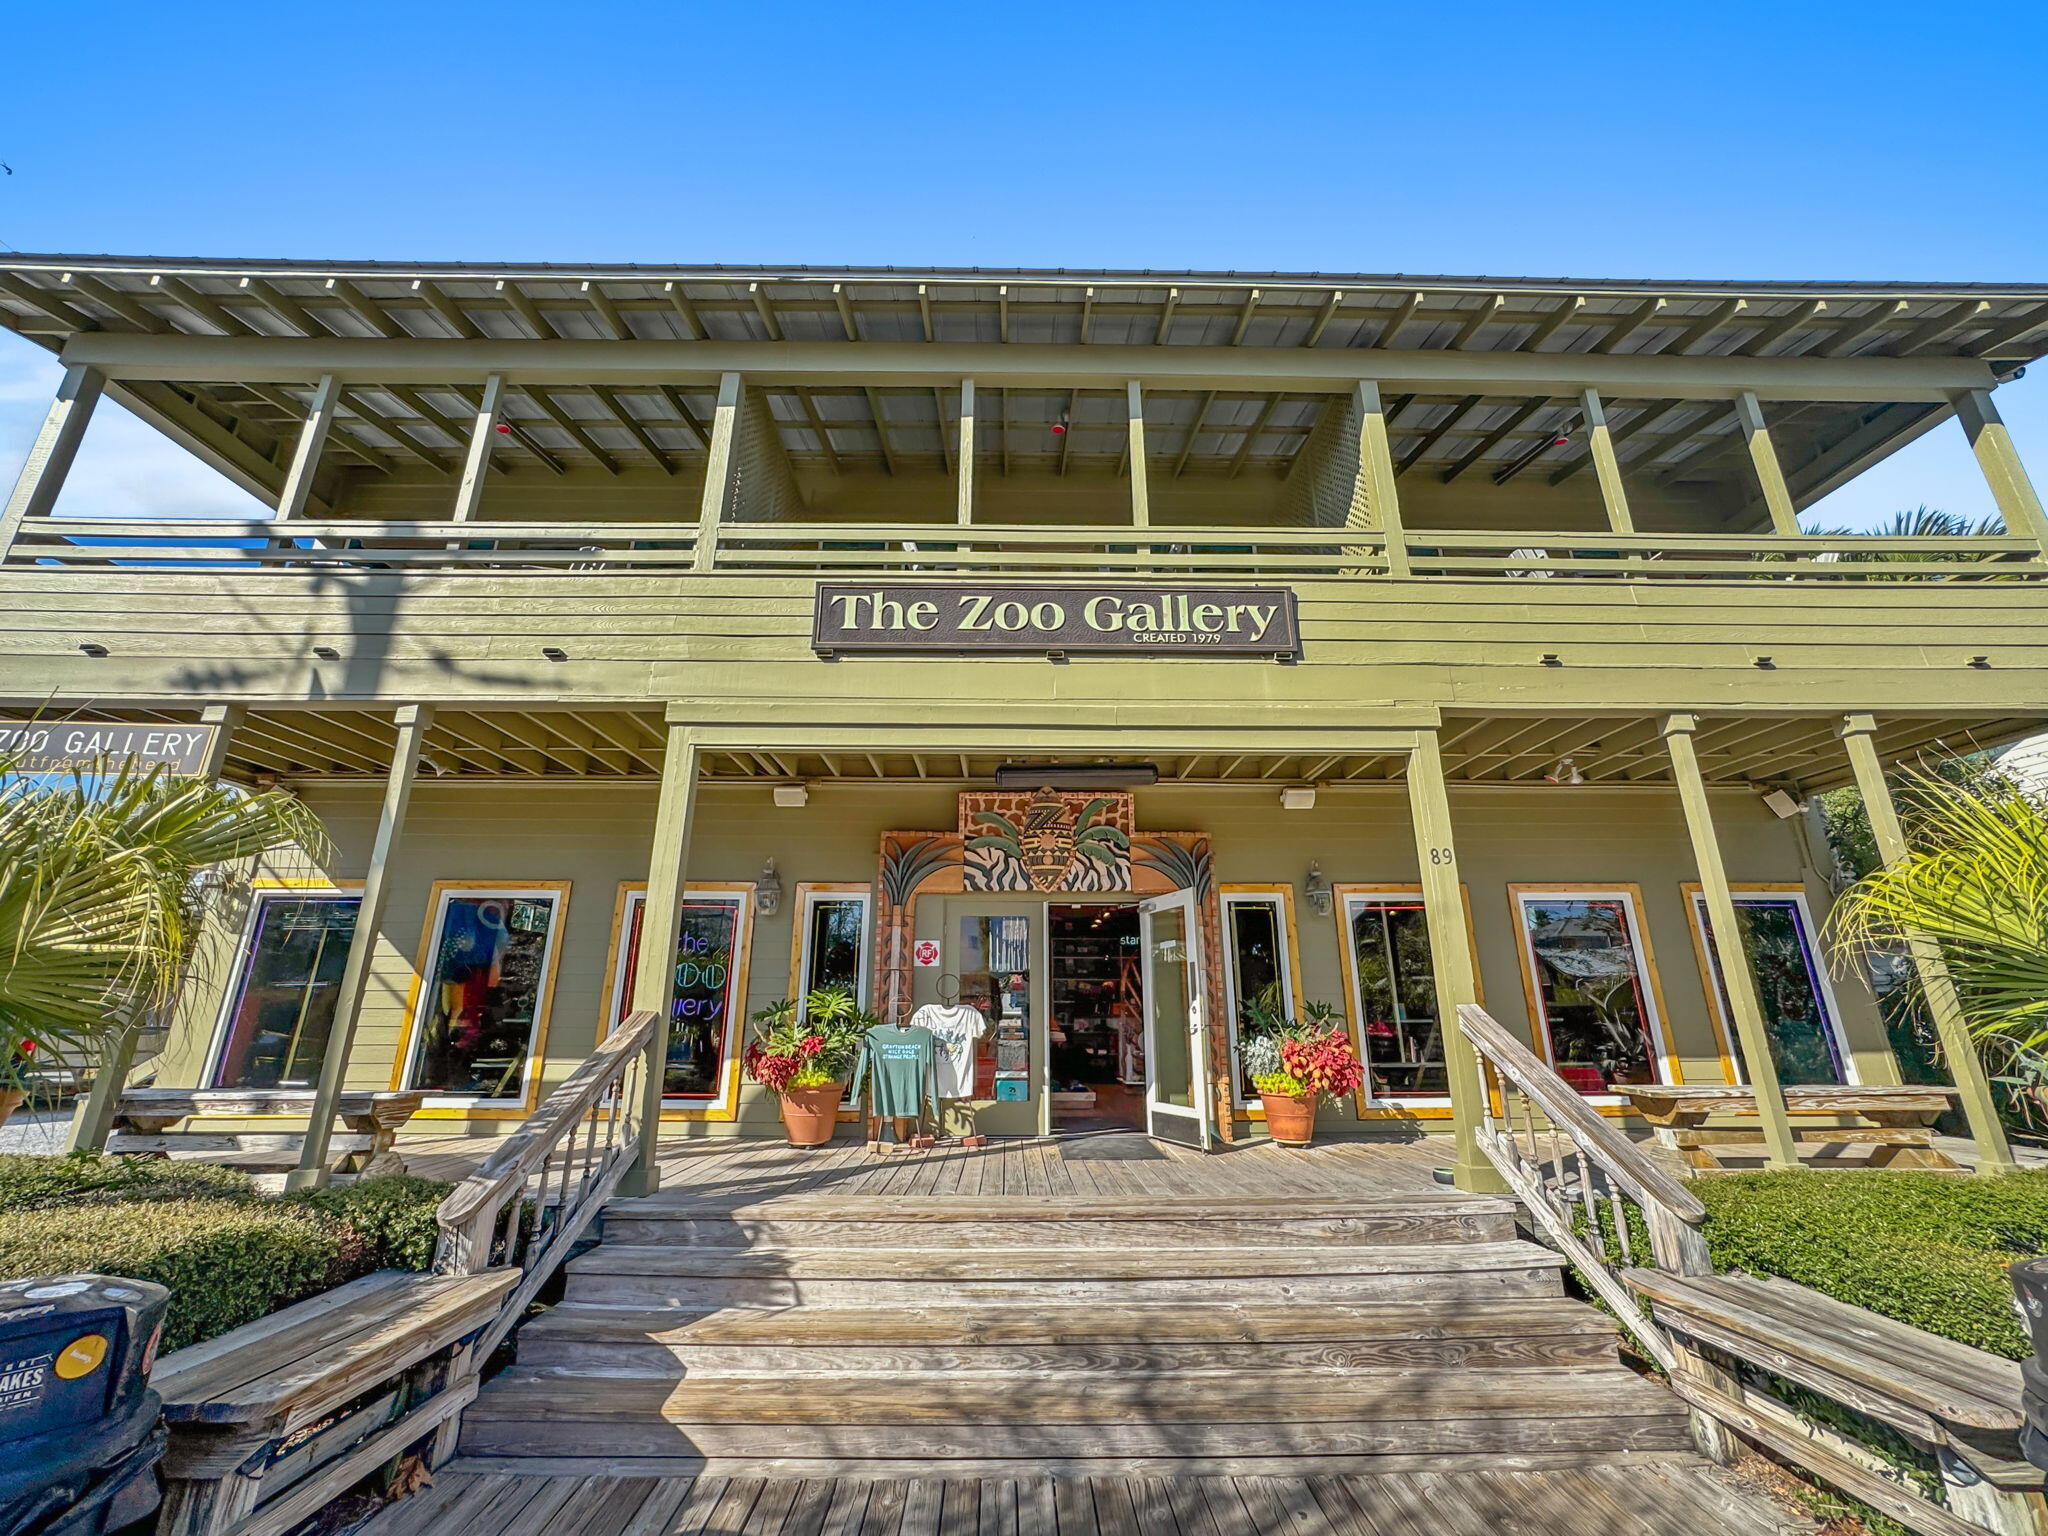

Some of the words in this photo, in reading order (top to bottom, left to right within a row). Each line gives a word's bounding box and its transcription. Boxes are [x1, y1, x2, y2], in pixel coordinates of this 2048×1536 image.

[830, 591, 939, 630] The
[957, 595, 1066, 631] Zoo
[1084, 594, 1278, 642] Gallery
[1133, 632, 1187, 643] CREATED
[1192, 633, 1221, 644] 1979
[65, 731, 203, 756] GALLERY
[1431, 848, 1453, 865] 89
[921, 949, 933, 958] RF
